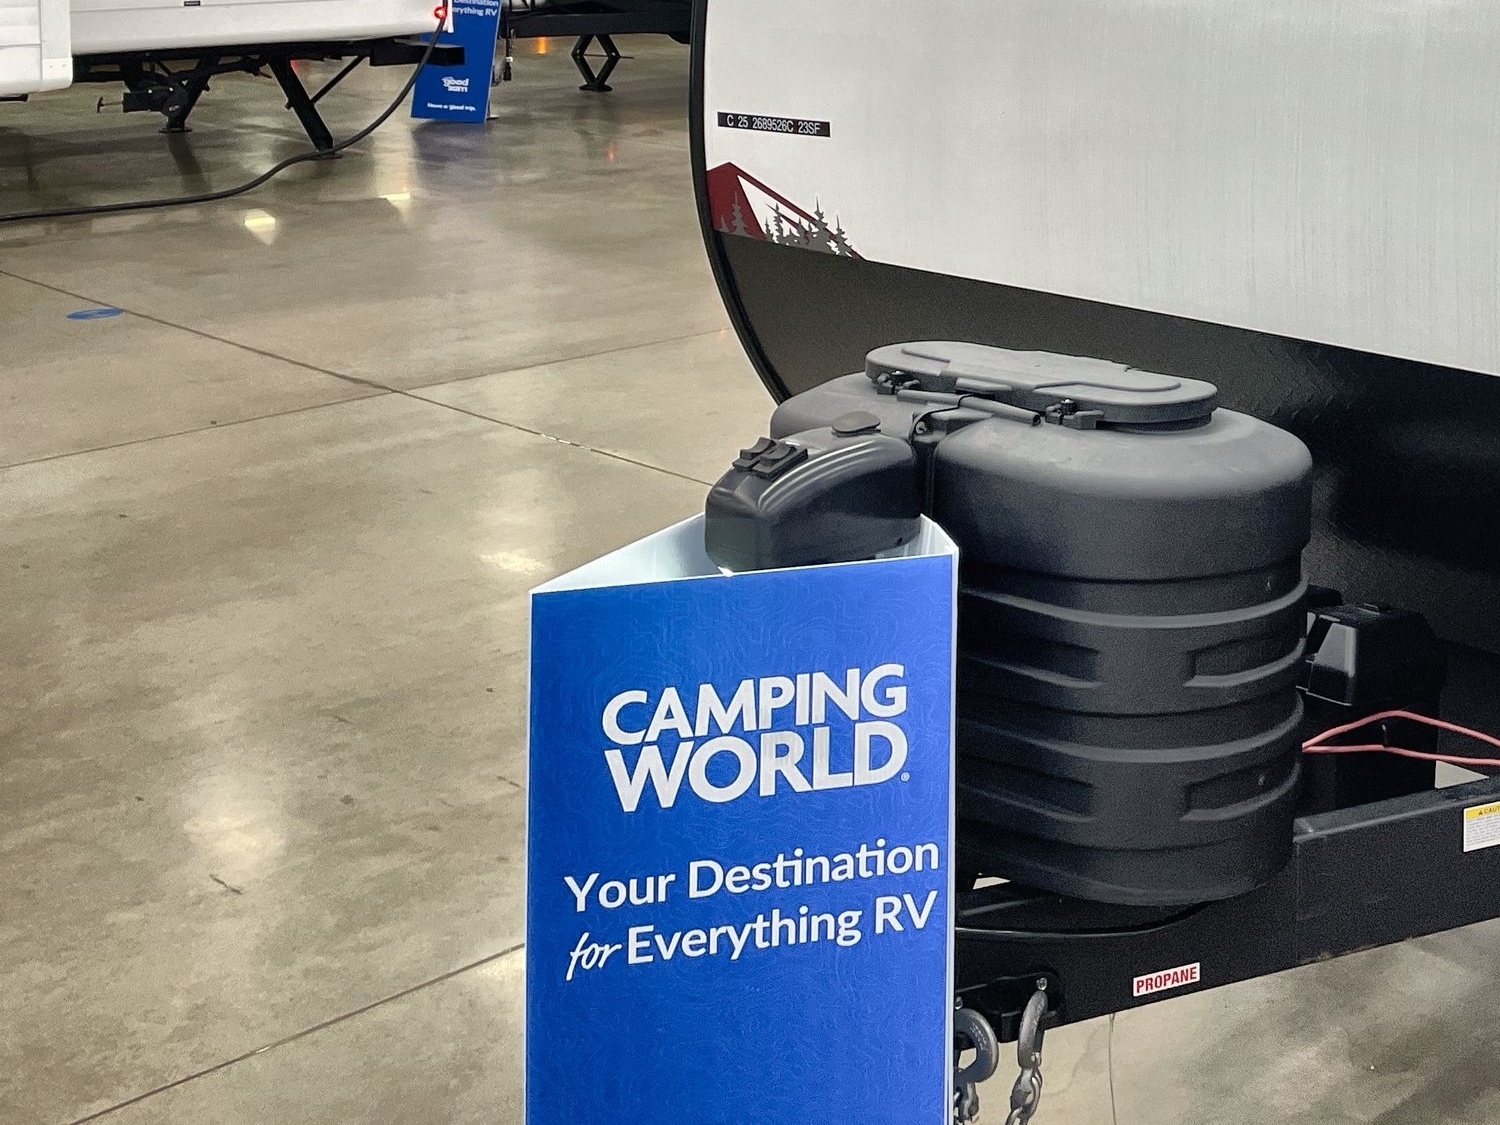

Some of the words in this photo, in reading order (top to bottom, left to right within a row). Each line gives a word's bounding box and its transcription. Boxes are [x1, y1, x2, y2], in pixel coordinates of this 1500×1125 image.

[485, 8, 498, 16] RV
[726, 115, 734, 127] C
[738, 116, 749, 128] 25
[798, 121, 821, 135] 23SF
[601, 664, 908, 746] CAMPING
[604, 721, 910, 812] WORLD
[564, 871, 677, 913] Your
[689, 839, 940, 900] Destination
[566, 932, 622, 981] for
[627, 906, 862, 965] Everything
[874, 891, 938, 937] RV
[1136, 966, 1197, 994] PROPANE
